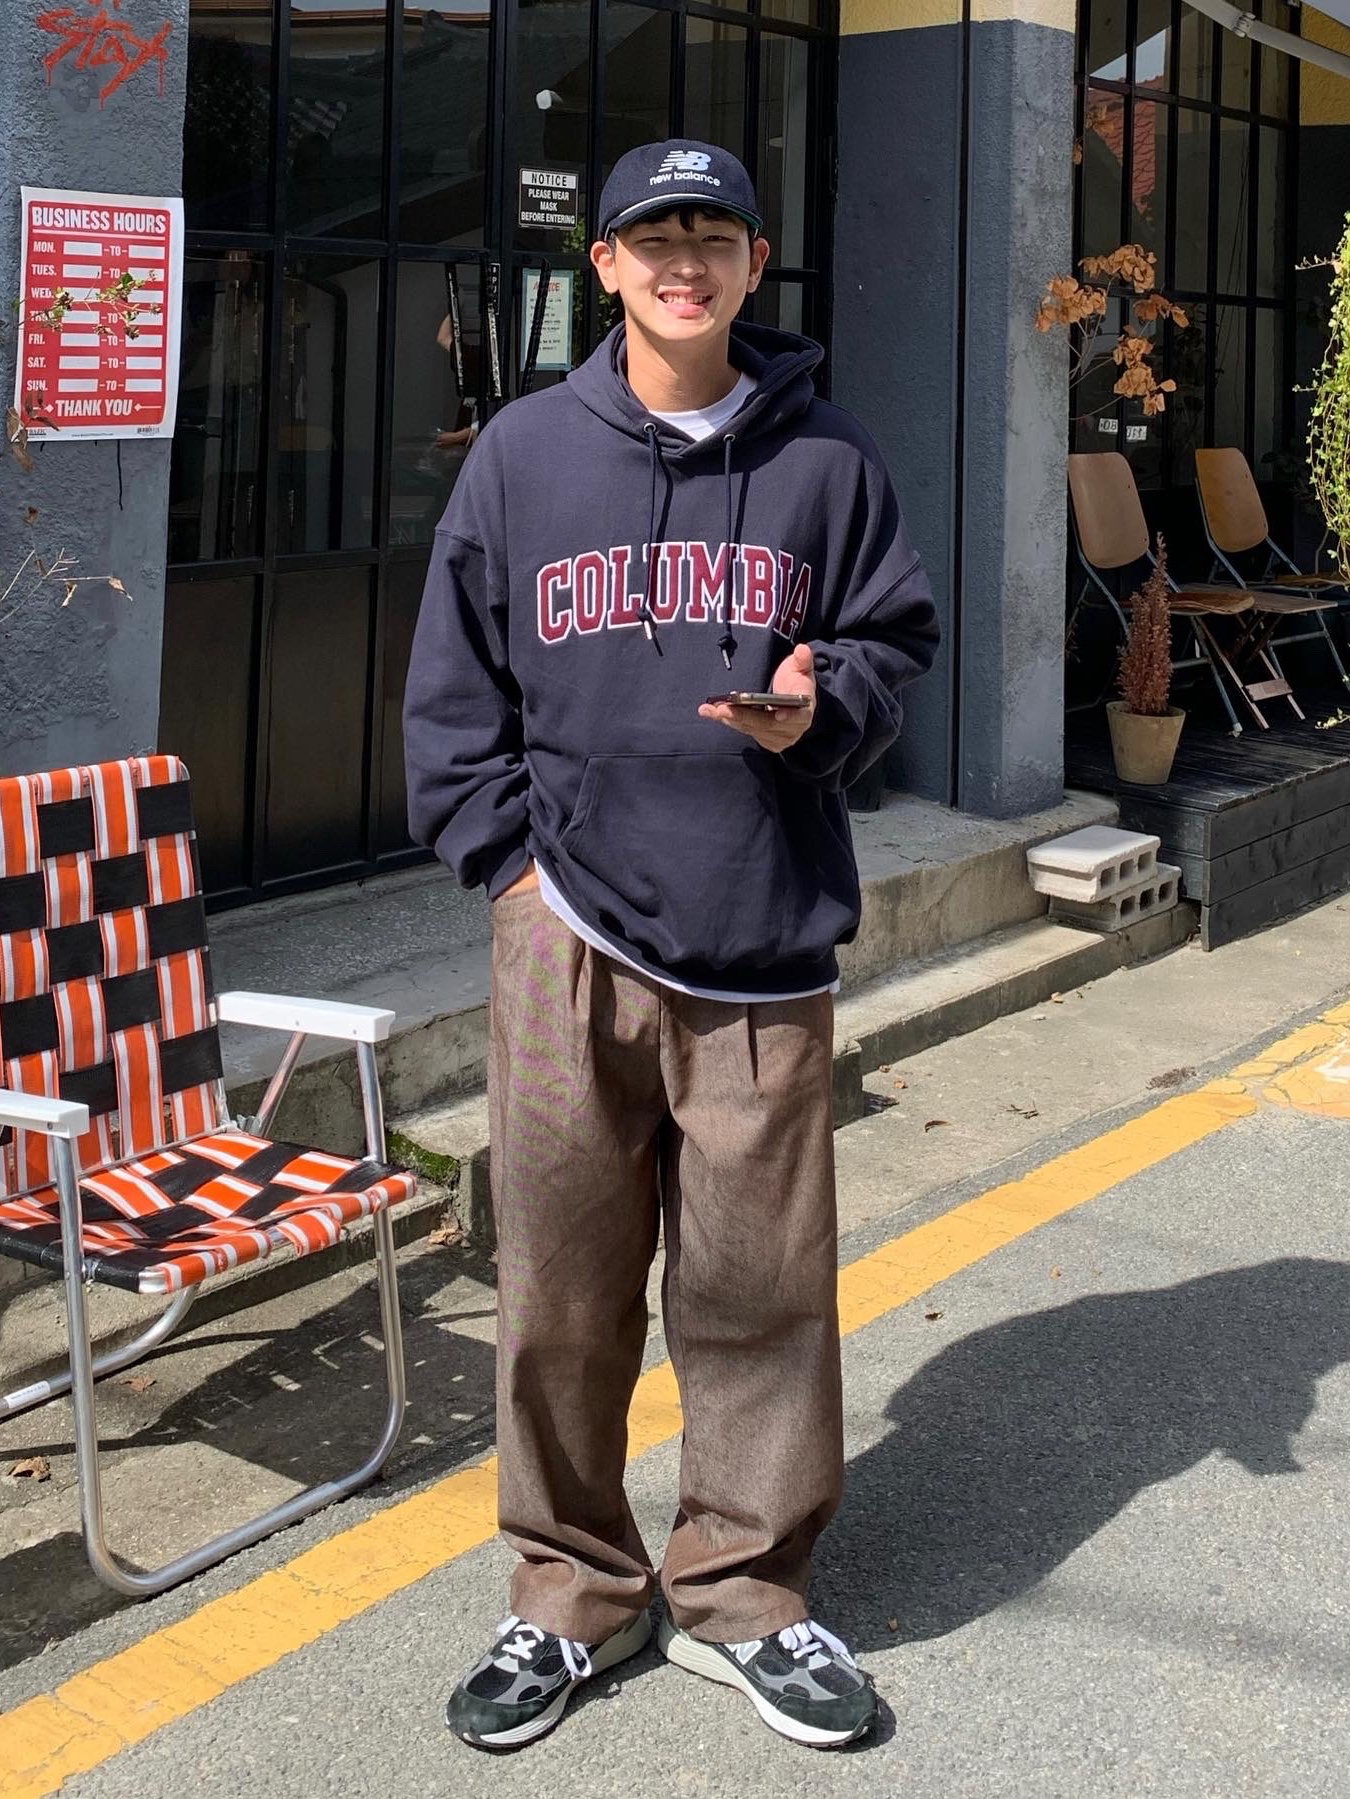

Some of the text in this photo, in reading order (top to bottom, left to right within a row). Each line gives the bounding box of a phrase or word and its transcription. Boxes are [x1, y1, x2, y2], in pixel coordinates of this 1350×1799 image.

[531, 173, 567, 186] NOTICE
[649, 171, 721, 187] new balance
[528, 188, 569, 201] PLEASE WEAR
[540, 201, 557, 211] MASK
[31, 206, 167, 235] BUSINESS HOURS
[521, 211, 575, 224] BEFORE ENTERING
[33, 241, 57, 254] MON.
[31, 263, 58, 277] TUES.
[30, 287, 55, 300] WED.
[28, 333, 46, 346] FRI.
[27, 356, 47, 369] SAT.
[26, 379, 49, 392] SUN.
[55, 399, 133, 417] THANK YOU
[536, 540, 812, 645] COLUMBIA
